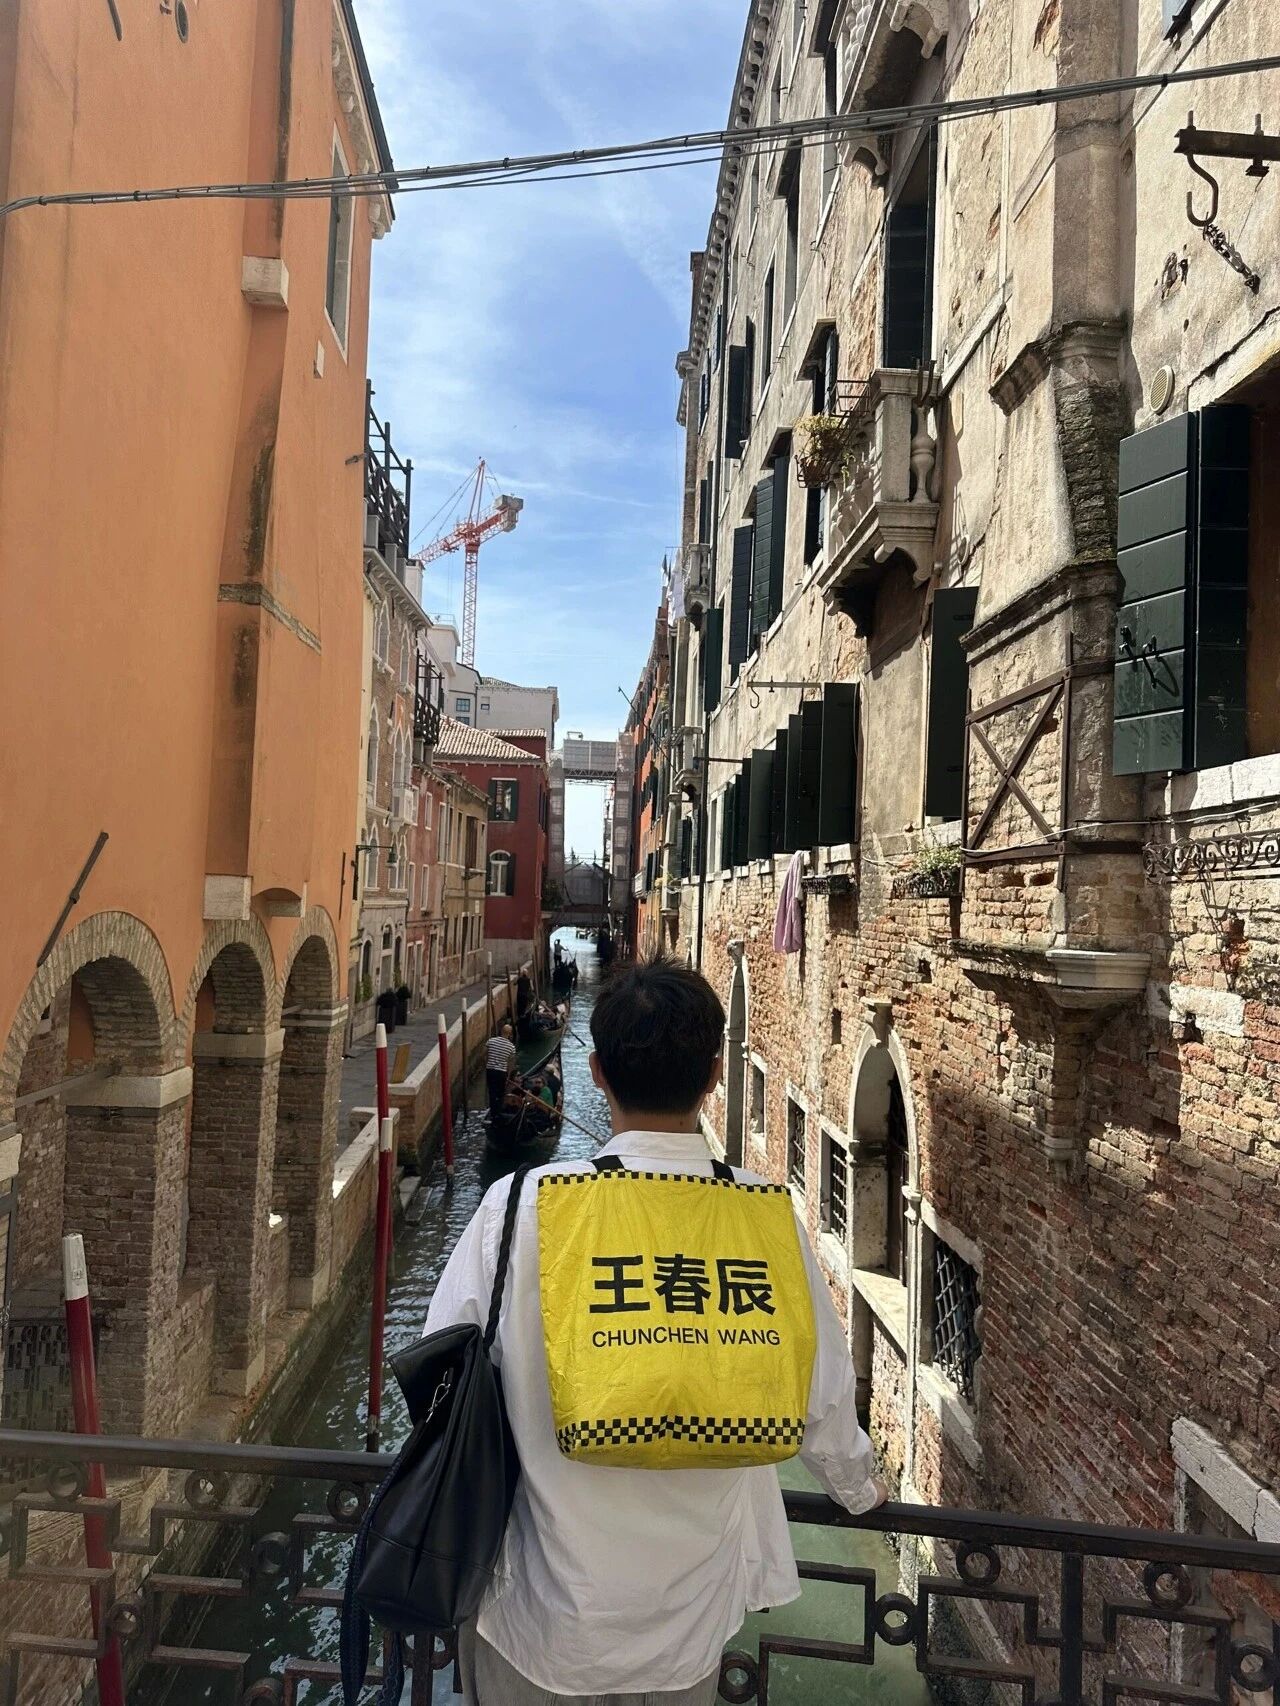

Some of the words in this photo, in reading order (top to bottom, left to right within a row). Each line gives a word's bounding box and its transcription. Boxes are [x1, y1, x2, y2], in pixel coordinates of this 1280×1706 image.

[589, 1253, 777, 1316] 王春辰
[592, 1326, 709, 1348] CHUNCHEN
[717, 1329, 780, 1346] WANG
